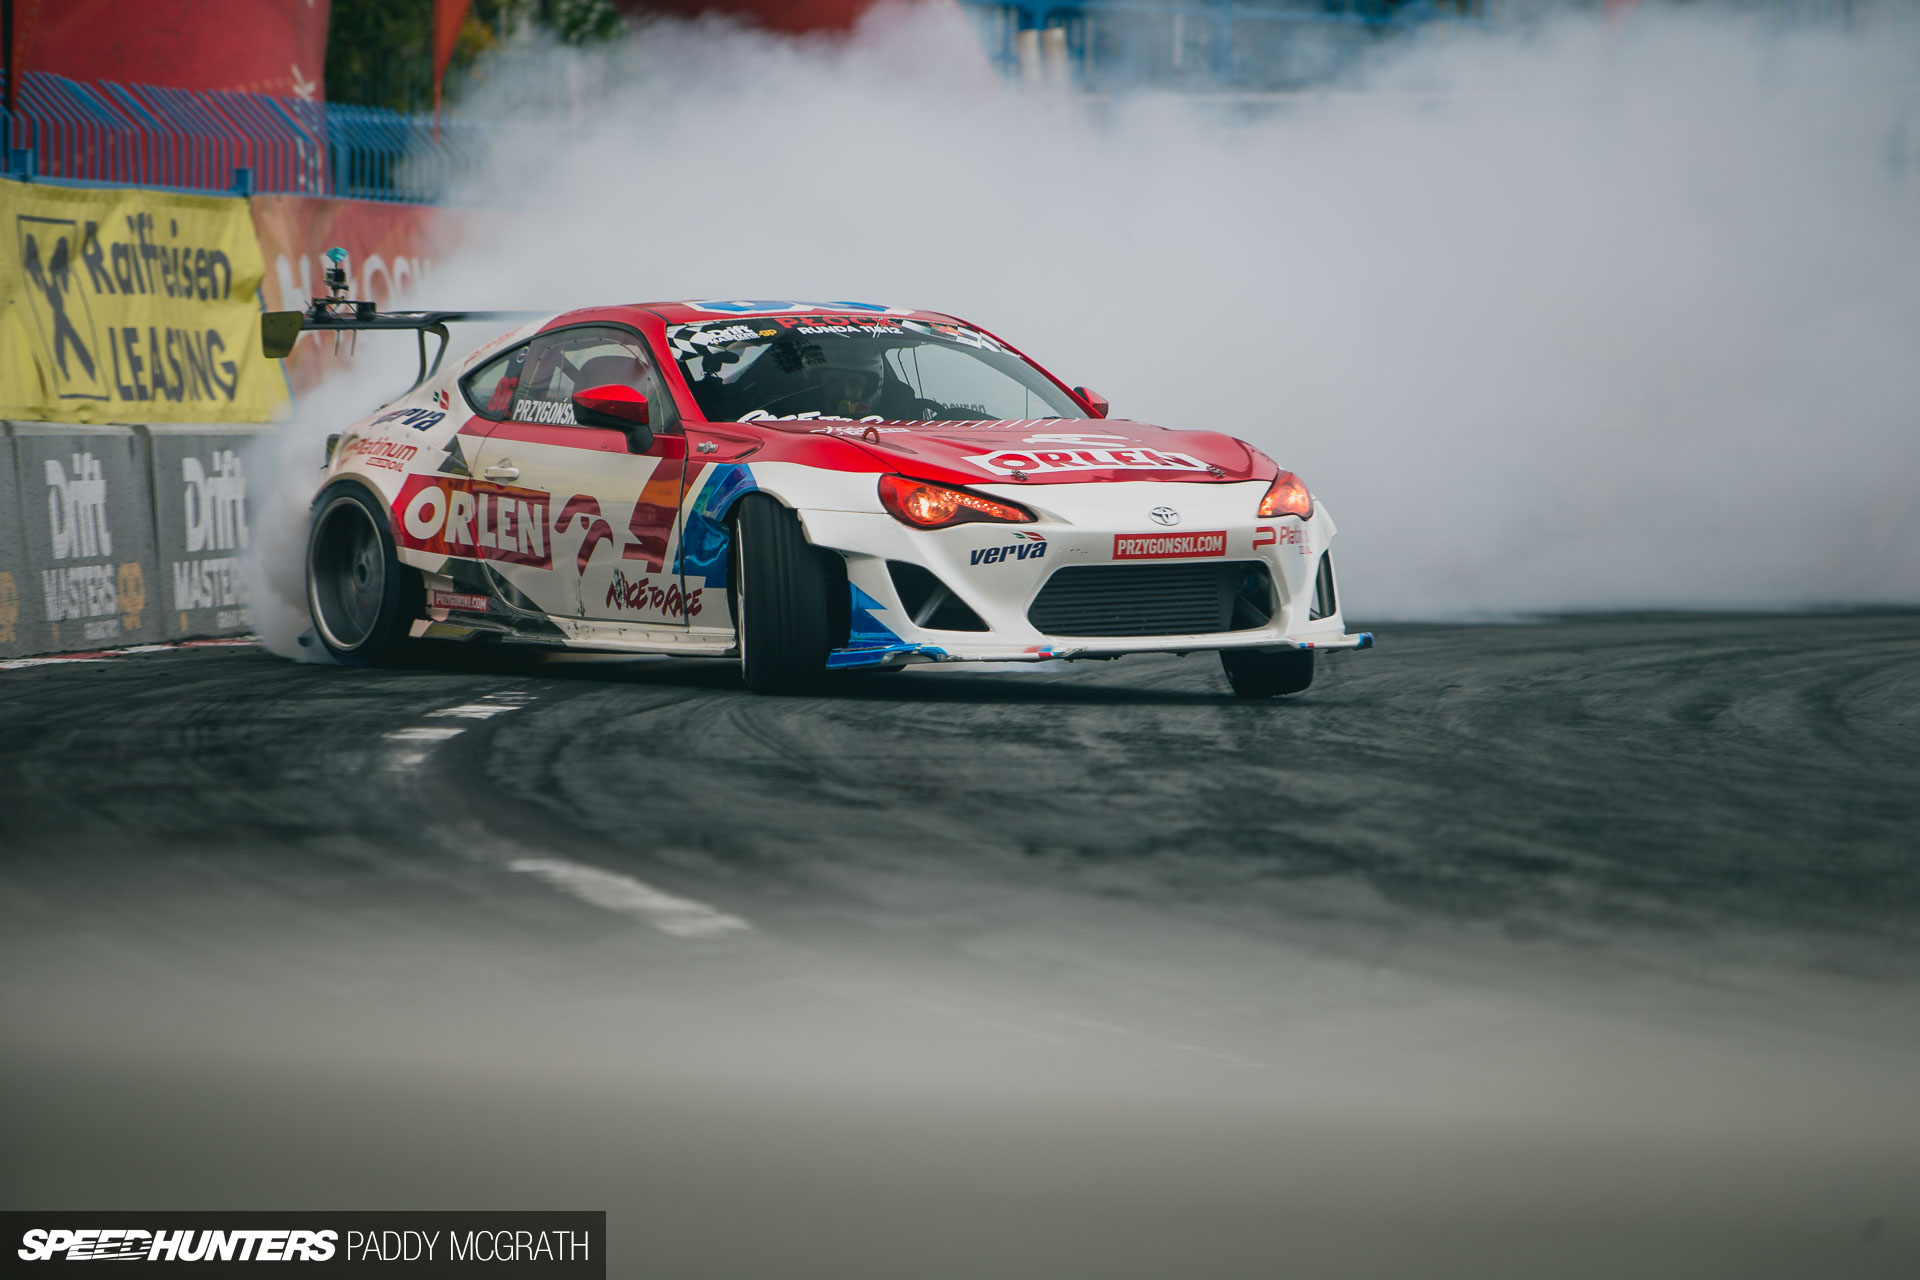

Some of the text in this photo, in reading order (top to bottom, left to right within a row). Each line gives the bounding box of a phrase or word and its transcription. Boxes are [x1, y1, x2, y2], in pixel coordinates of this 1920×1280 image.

[797, 325, 860, 335] RUNDA
[108, 327, 238, 402] LEASING
[512, 397, 578, 425] PRZYGOŃSK
[988, 450, 1199, 470] ORLEN
[45, 452, 112, 559] Drift
[182, 450, 249, 552] Drift
[404, 486, 545, 557] ORLEN
[970, 542, 1047, 565] verva
[1117, 536, 1223, 555] PRZYGONSKI.COM
[648, 586, 664, 610] TO
[662, 584, 702, 618] RACE
